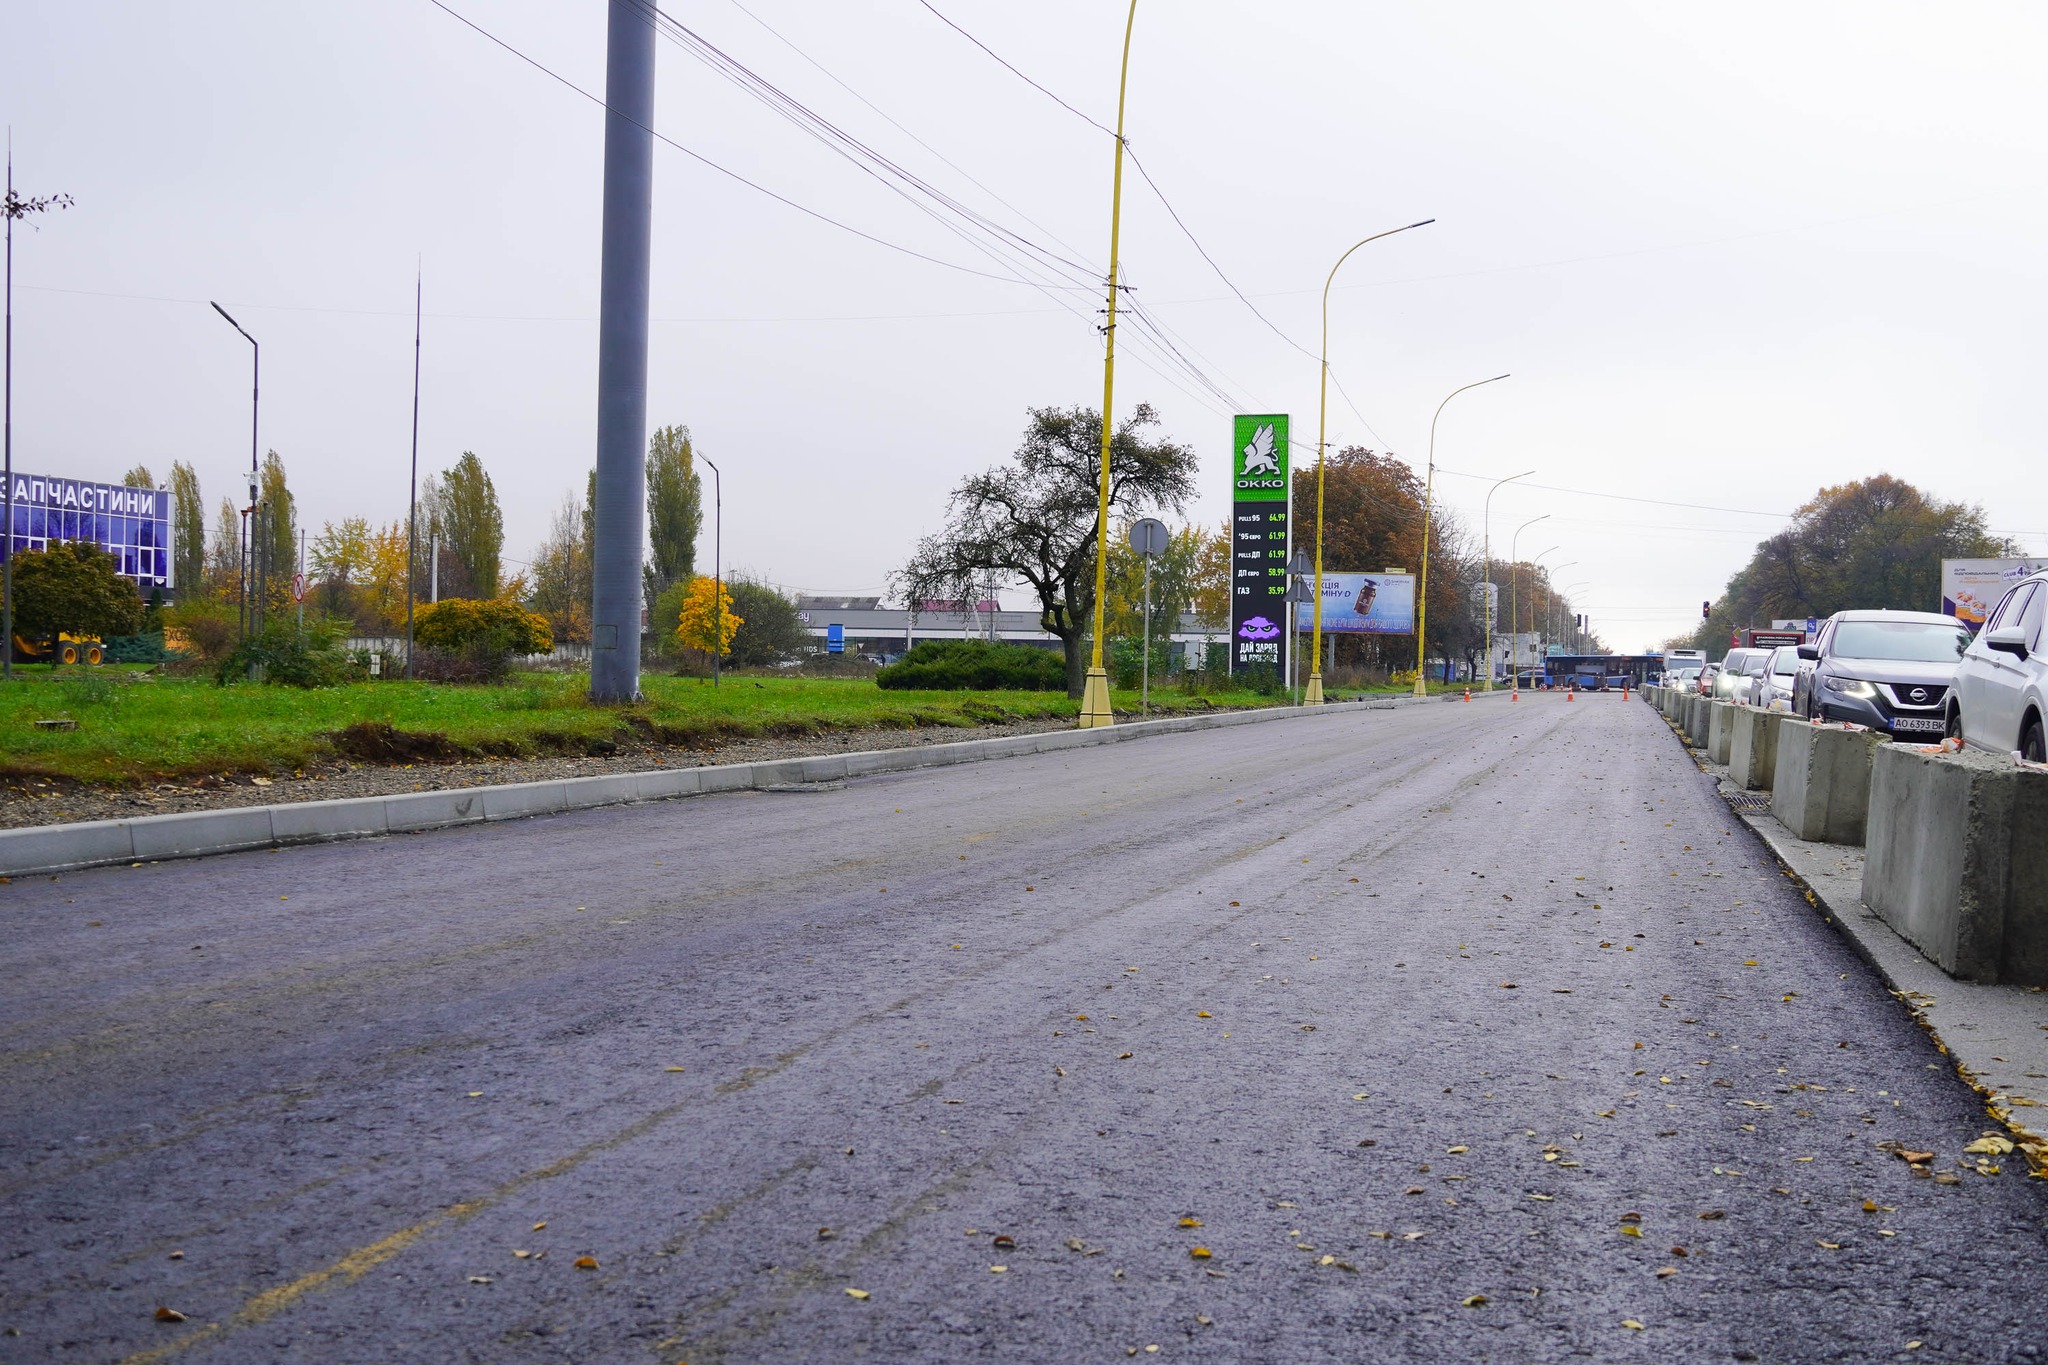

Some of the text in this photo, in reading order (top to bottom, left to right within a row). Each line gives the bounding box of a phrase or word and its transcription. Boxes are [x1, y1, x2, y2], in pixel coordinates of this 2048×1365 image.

[1237, 480, 1284, 488] OKKO
[1269, 532, 1286, 540] 61.99
[1252, 551, 1260, 559] ДП
[1269, 550, 1285, 558] 61.99
[1238, 569, 1247, 577] ДП
[1268, 569, 1285, 577] 58.99
[2017, 566, 2024, 577] 4
[1238, 587, 1285, 595] ГАЗ 35.99
[1344, 590, 1351, 598] D
[1239, 641, 1254, 654] ДАЙ
[1895, 719, 1945, 730] AO 6393 BK
